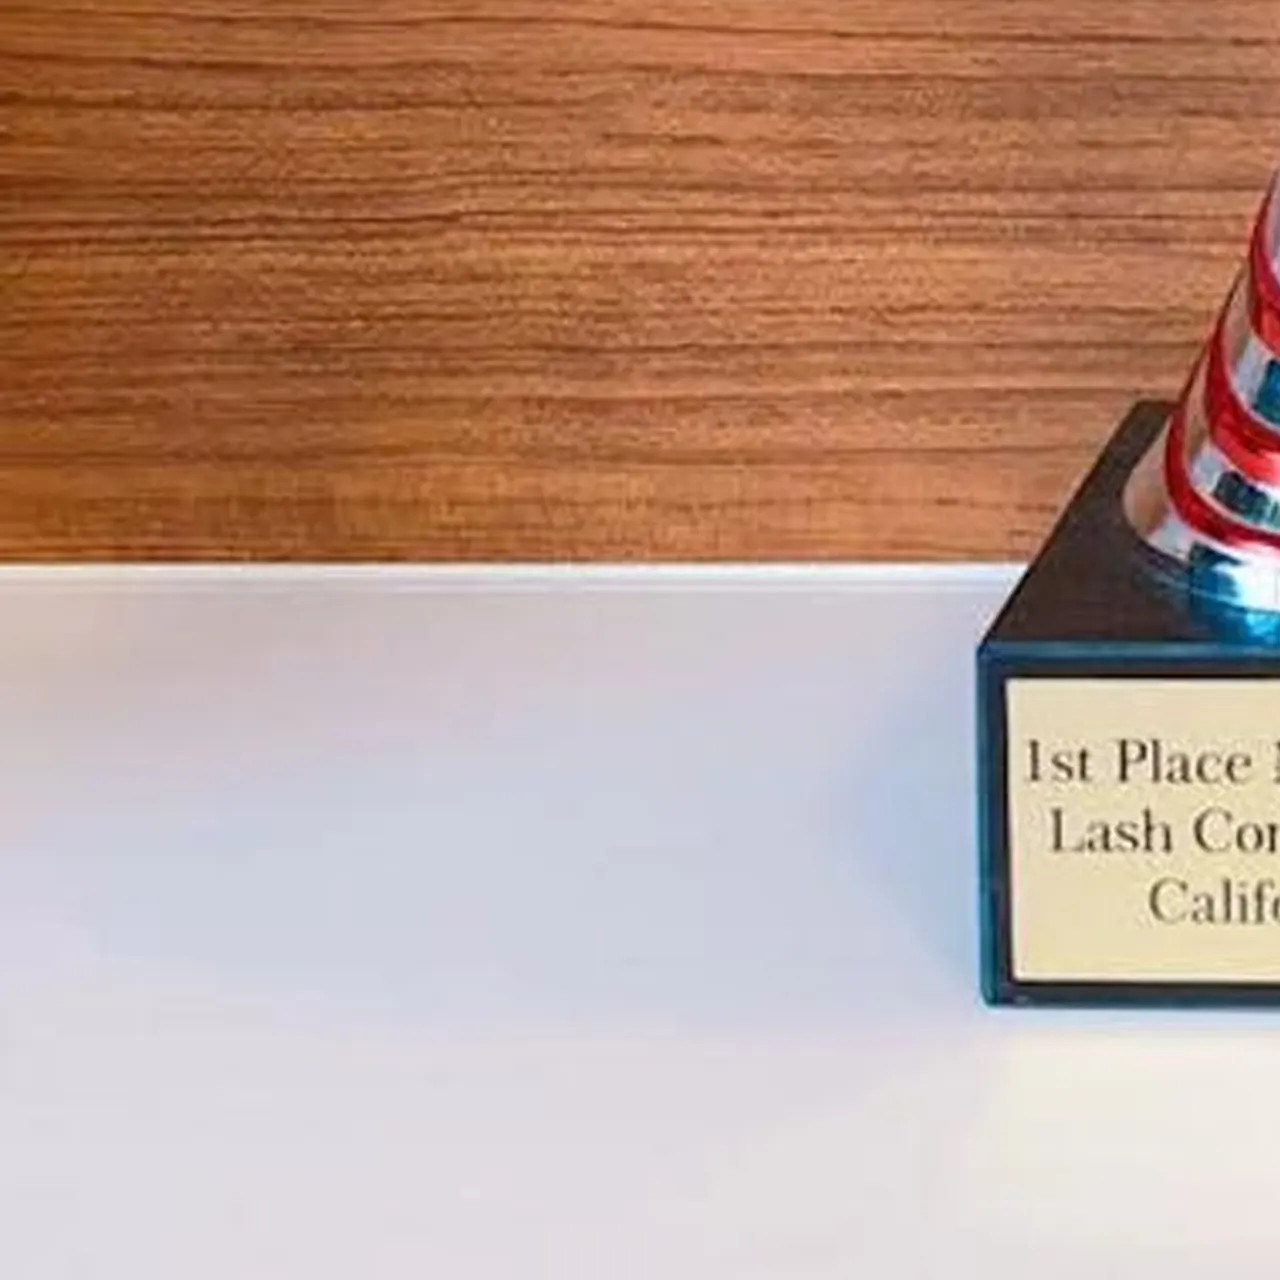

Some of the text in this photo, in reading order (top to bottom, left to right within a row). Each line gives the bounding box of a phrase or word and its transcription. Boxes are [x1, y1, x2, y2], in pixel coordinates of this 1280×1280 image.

[1027, 737, 1093, 784] 1st
[1116, 736, 1254, 786] Place
[1050, 805, 1174, 856] Lash
